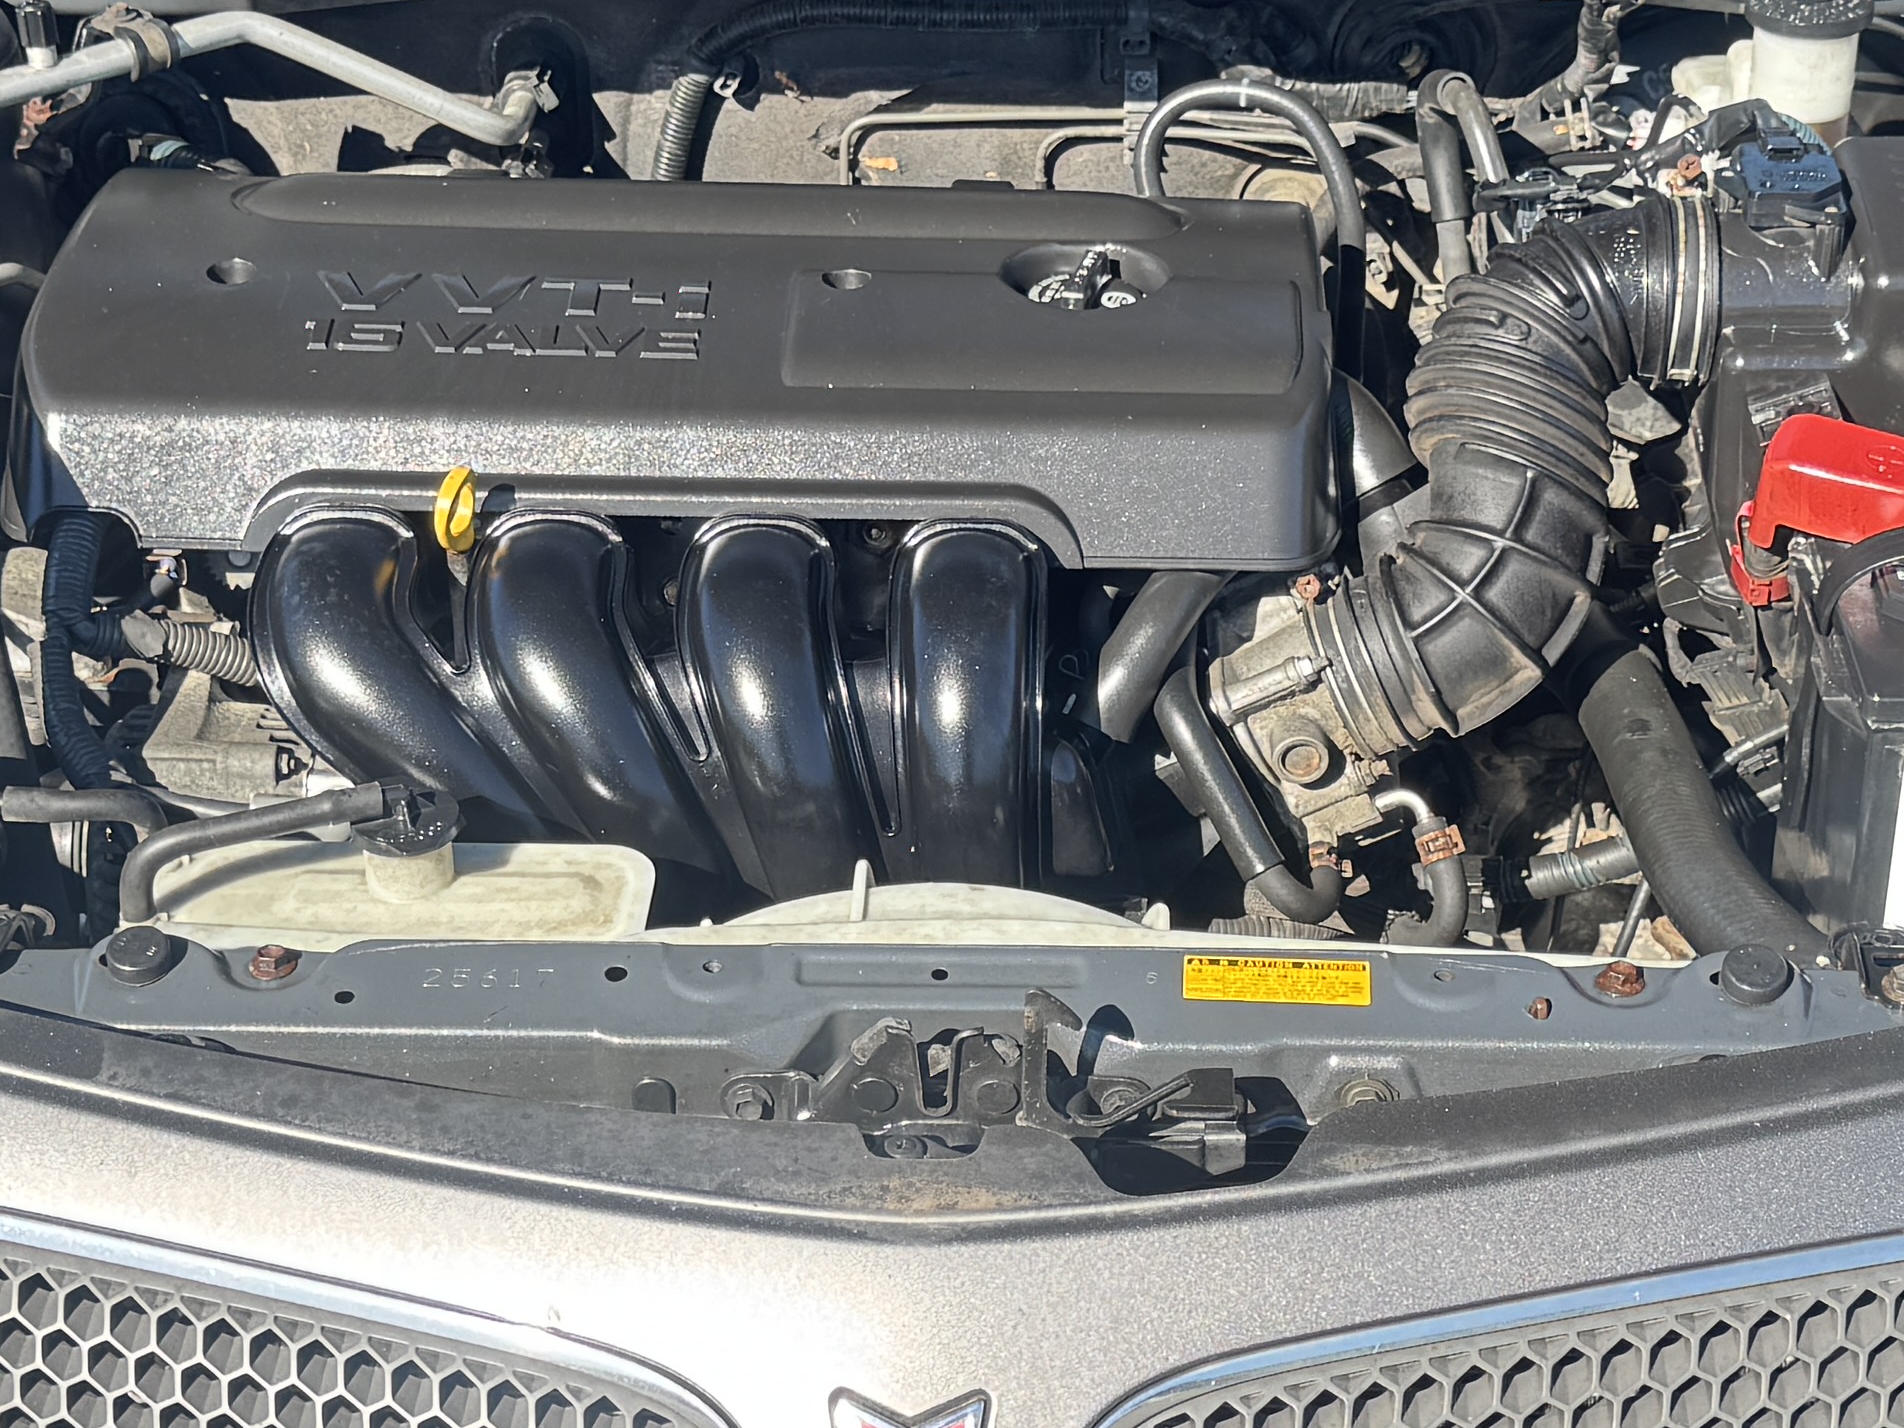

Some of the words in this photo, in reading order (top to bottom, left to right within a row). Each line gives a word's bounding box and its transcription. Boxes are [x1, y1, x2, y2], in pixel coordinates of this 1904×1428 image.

[305, 318, 406, 353] 16
[416, 321, 702, 359] VALVE
[1237, 959, 1294, 968] CAUTION
